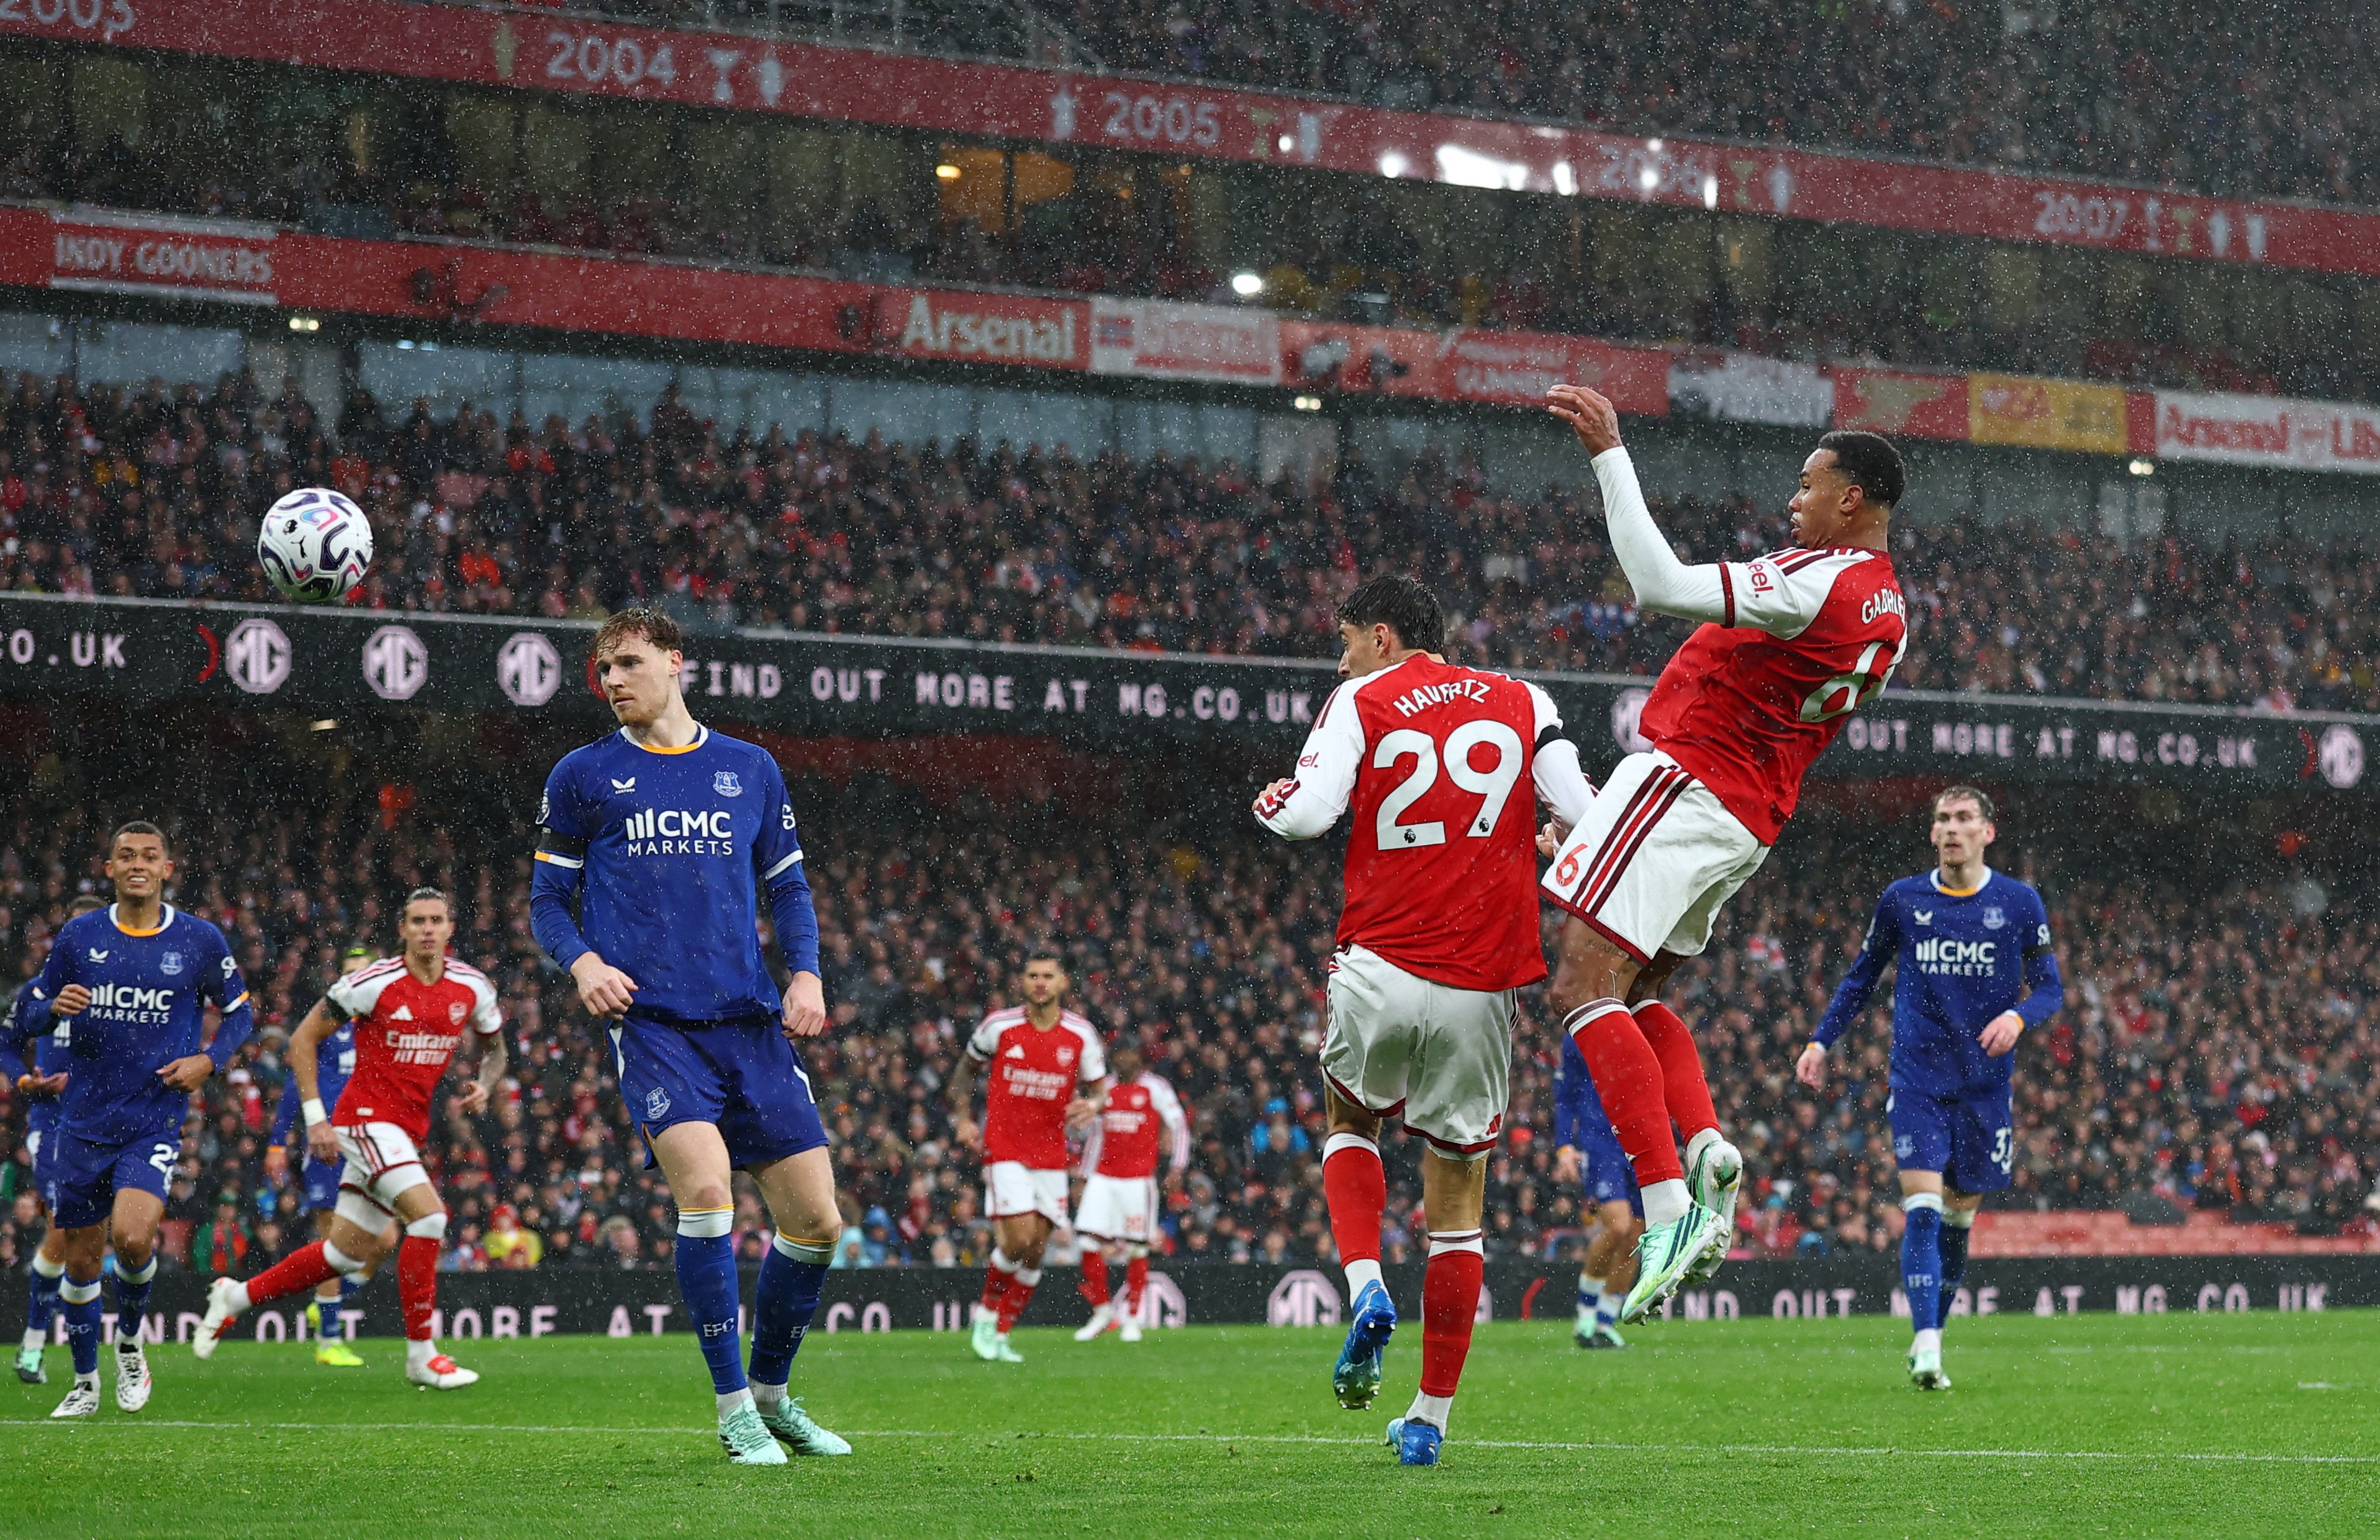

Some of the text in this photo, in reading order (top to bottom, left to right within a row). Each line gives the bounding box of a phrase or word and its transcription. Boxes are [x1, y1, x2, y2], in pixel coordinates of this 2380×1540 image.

[547, 32, 676, 87] 2004
[1105, 91, 1221, 146] 2005
[2034, 191, 2130, 239] 2007
[902, 295, 1075, 360] Arsenal
[1745, 562, 1773, 598] eel.
[0, 628, 126, 669] O.UK
[228, 622, 289, 691] MG
[366, 628, 425, 697] MG
[502, 634, 558, 704] MG
[681, 659, 1313, 723] FIND OUT MORE AT MG.CO.UK
[1393, 678, 1491, 717] HAVERTZ
[1848, 717, 1909, 752] OUT
[1932, 722, 2014, 757] MORE
[2035, 727, 2076, 759] AT
[1373, 719, 1523, 851] 29
[658, 810, 732, 838] CMC
[628, 840, 733, 856] MARKETS
[1557, 843, 1588, 887] 6
[1939, 940, 1996, 963] CMC
[89, 1007, 170, 1024] MARKETS
[114, 986, 174, 1010] CMC
[2034, 1285, 2086, 1316] AT
[607, 1305, 672, 1338] AT
[703, 1318, 734, 1337] EFC
[790, 1324, 810, 1339] EF
